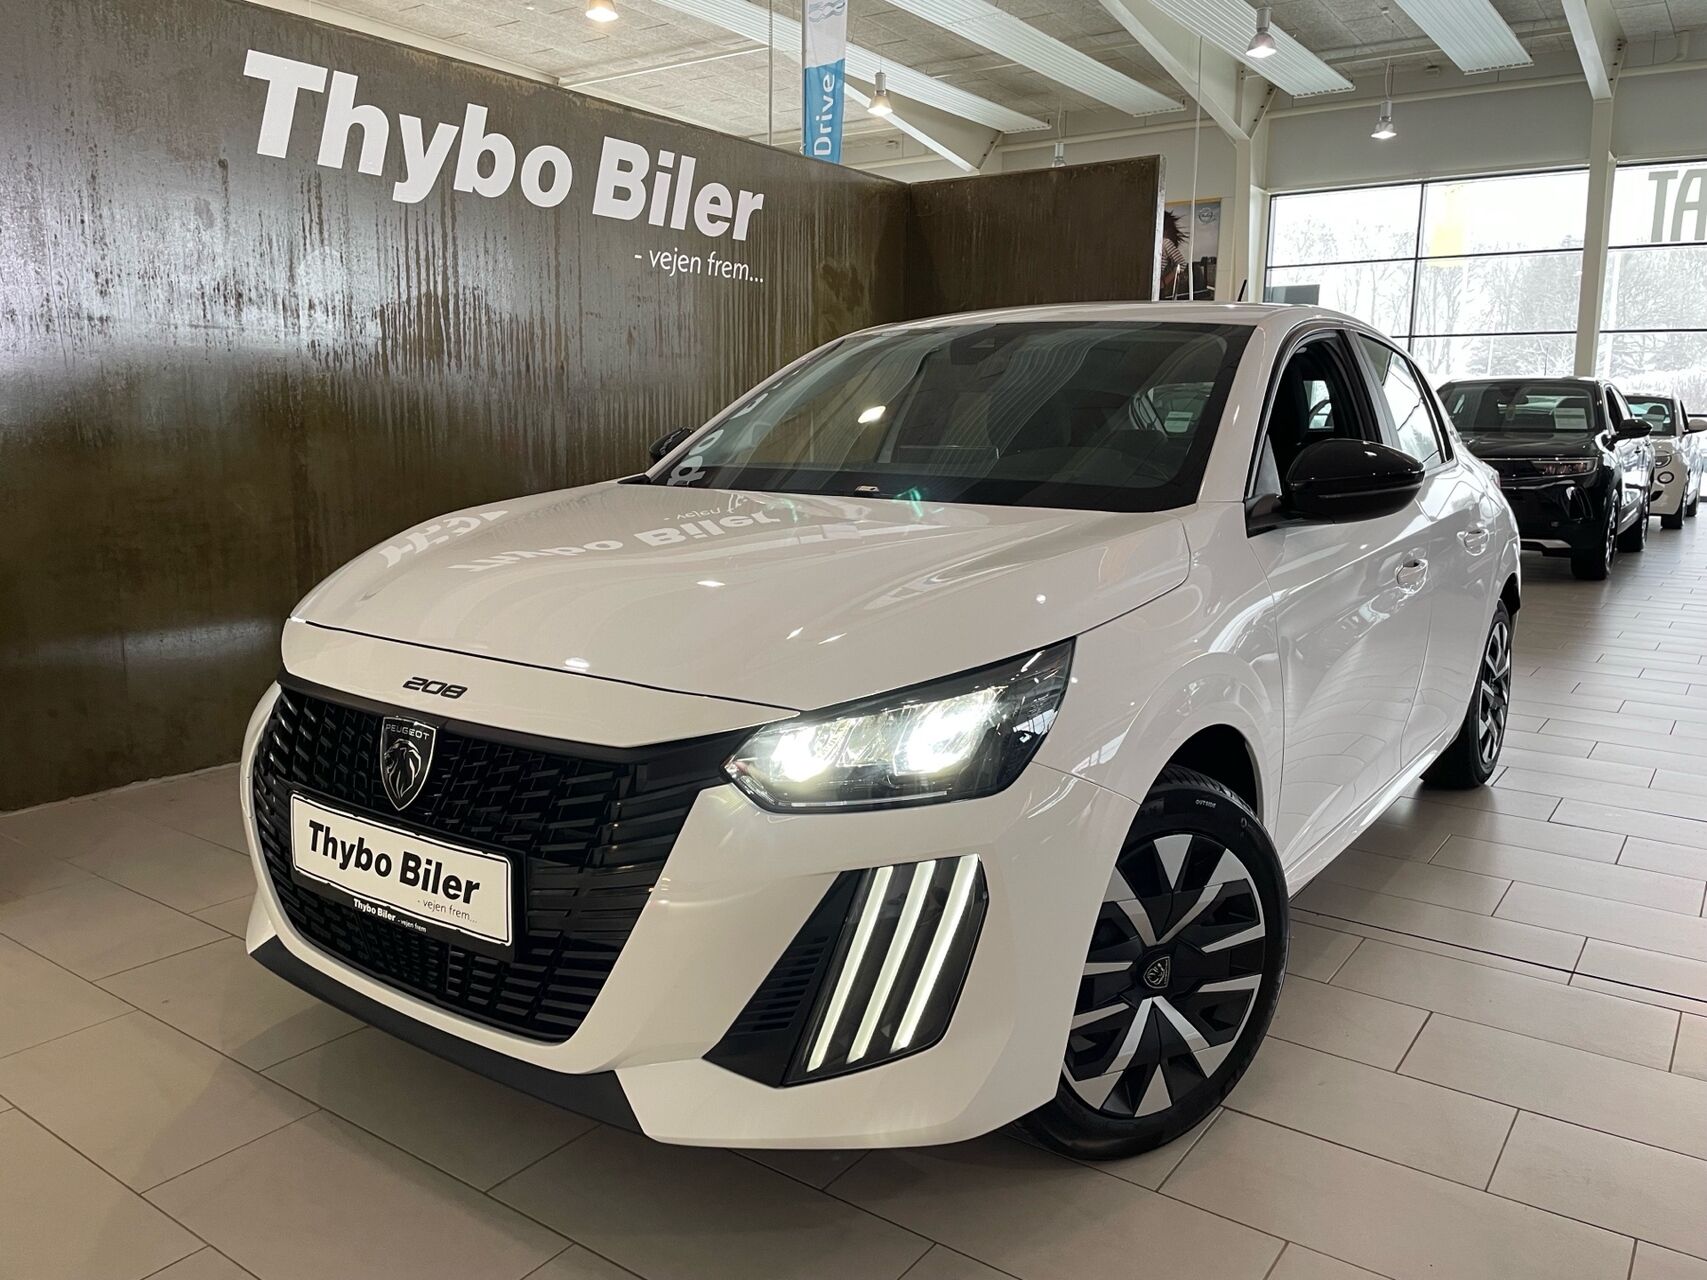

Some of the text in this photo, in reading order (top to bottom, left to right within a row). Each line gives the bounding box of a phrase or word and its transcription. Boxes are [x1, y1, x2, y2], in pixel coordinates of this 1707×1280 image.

[814, 74, 836, 156] Drive
[242, 50, 765, 241] Thybo Biler
[648, 248, 702, 278] vejen
[402, 676, 468, 700] 208
[385, 724, 430, 740] PEUGEOT
[309, 820, 481, 905] Thybo Biler
[353, 898, 376, 915] Thybo
[377, 907, 396, 922] Biler
[423, 899, 447, 914] vejen
